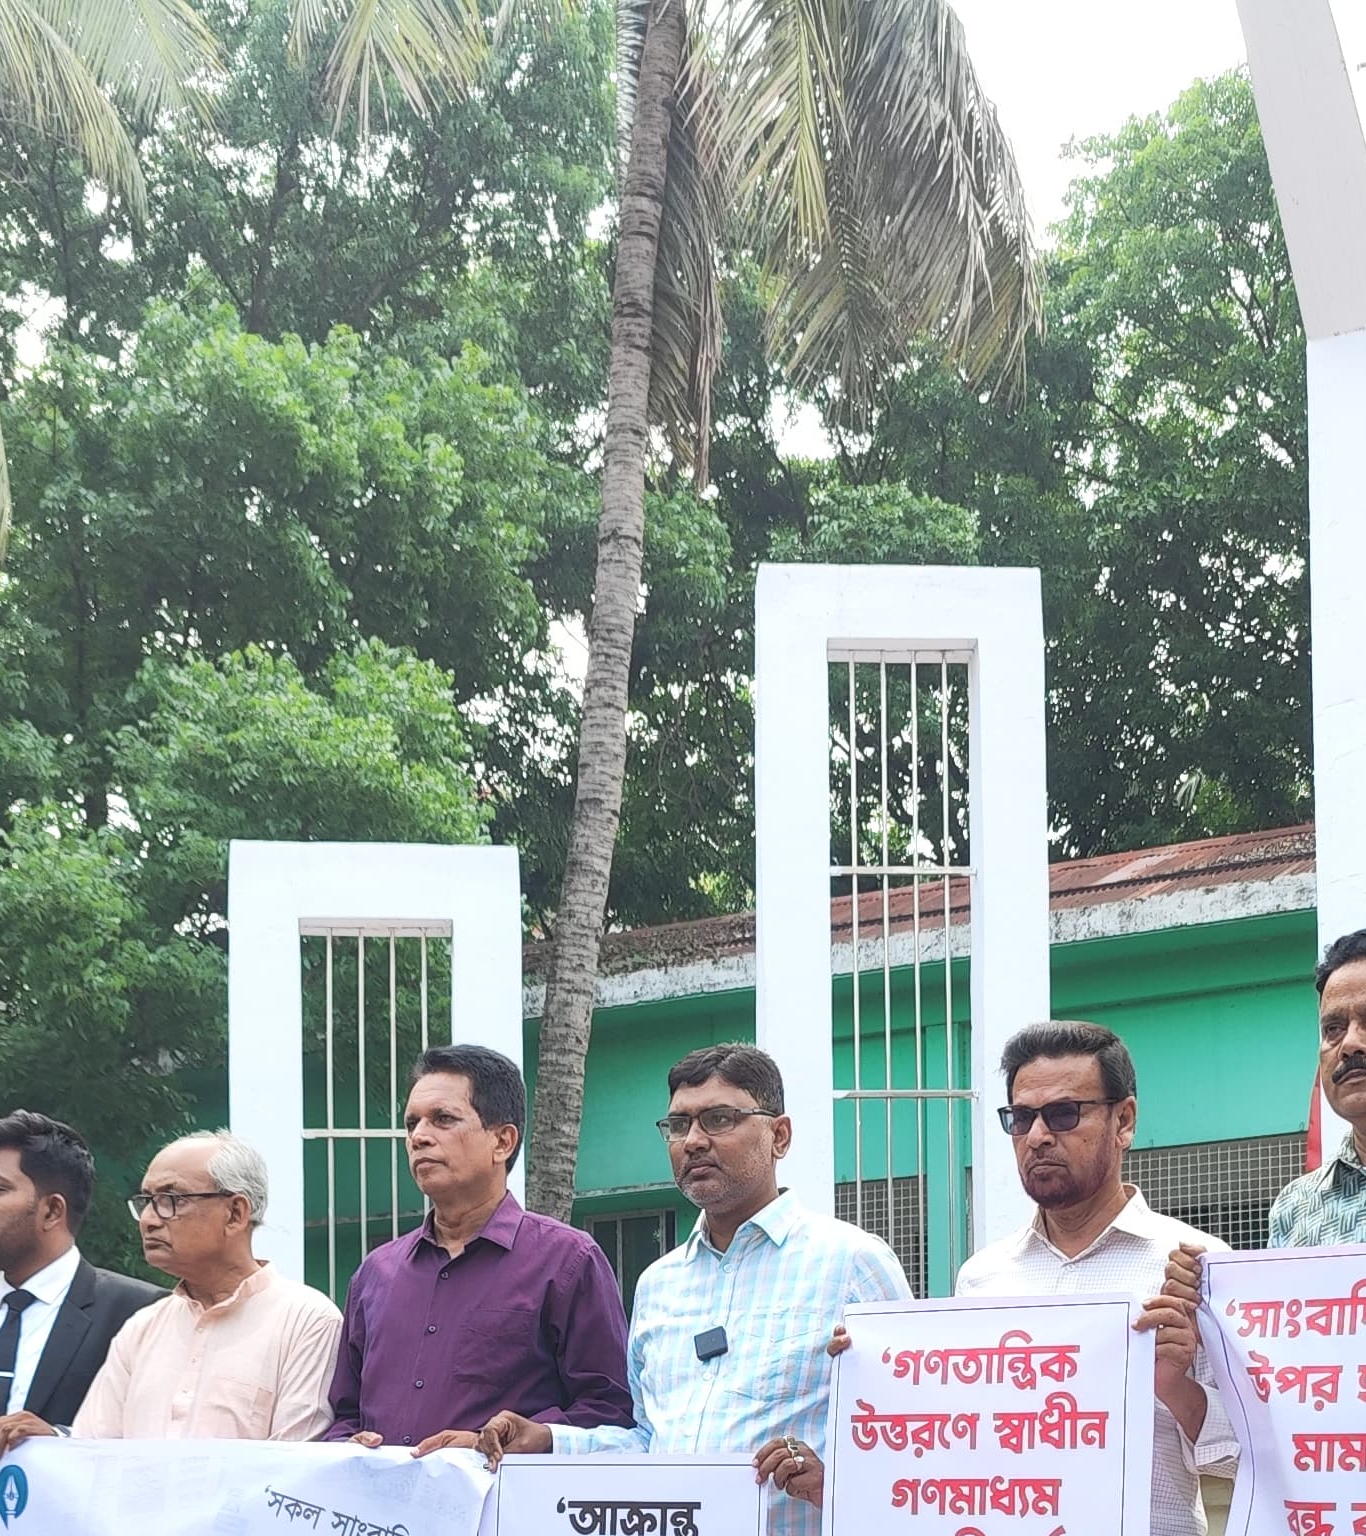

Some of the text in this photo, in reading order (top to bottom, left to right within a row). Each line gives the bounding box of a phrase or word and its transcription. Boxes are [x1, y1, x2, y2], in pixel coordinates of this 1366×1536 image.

[882, 1330, 1080, 1390] ‘গণতান্ত্রিক
[1248, 1351, 1343, 1412] উপর
[851, 1391, 1108, 1458] উত্তরণে স্বাধীন
[265, 1484, 326, 1529] ‘সকল
[891, 1476, 1062, 1518] গণমাধ্যম
